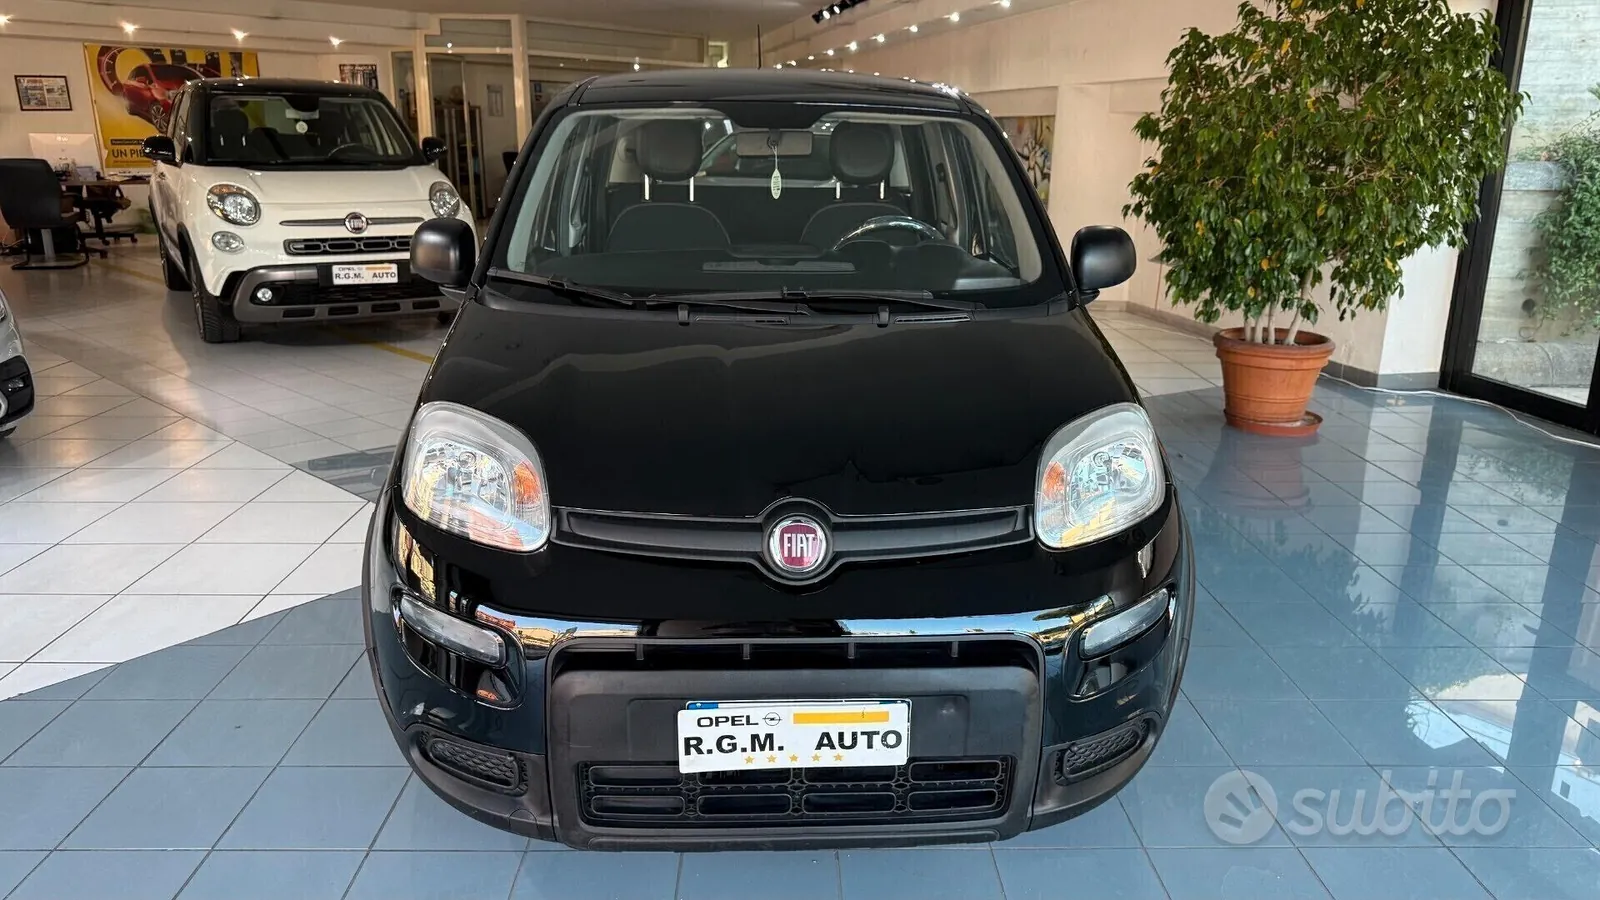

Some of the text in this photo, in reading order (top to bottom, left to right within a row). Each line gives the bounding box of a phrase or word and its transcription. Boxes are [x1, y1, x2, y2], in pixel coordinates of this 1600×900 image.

[111, 149, 145, 158] UN PIE
[335, 271, 397, 280] R.G.M. AUTO
[783, 533, 816, 558] FIAT
[696, 714, 759, 728] OPEL
[684, 729, 903, 756] R.G.M. AUTO
